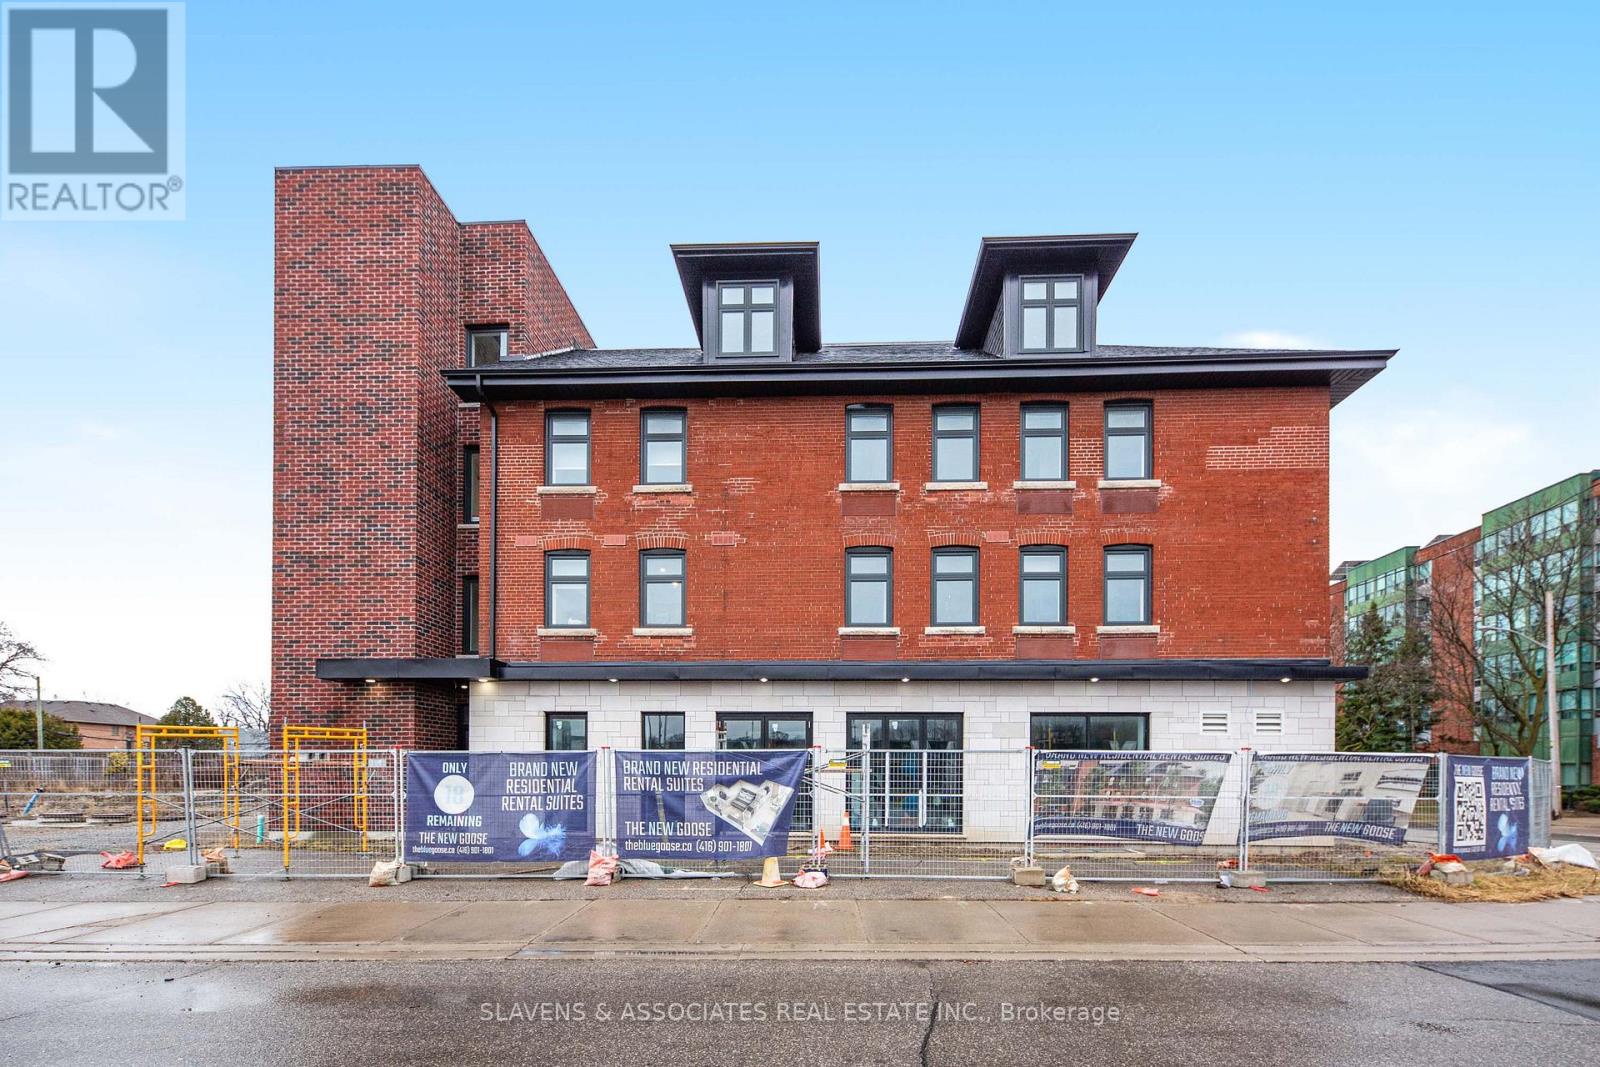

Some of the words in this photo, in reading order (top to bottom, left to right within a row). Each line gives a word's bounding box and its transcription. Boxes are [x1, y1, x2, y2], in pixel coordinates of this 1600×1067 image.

[442, 762, 468, 774] ONLY
[509, 761, 547, 777] BRAND
[551, 761, 579, 776] NEW
[623, 760, 661, 775] BRAND
[664, 761, 691, 775] NEW
[692, 761, 763, 776] RESIDENTIAL
[506, 778, 578, 794] RESIDENTIAL
[623, 777, 664, 792] RENTAL
[666, 777, 704, 792] SUITES
[501, 795, 543, 811] RENTAL
[545, 795, 584, 810] SUITES
[426, 815, 482, 827] REMAINING
[625, 821, 645, 836] THE
[648, 822, 674, 836] NEW
[676, 822, 712, 837] GOOSE
[419, 831, 436, 844] THE
[437, 832, 458, 844] NEW
[459, 832, 488, 845] GOOSE
[1136, 823, 1154, 836] THE
[1156, 826, 1179, 839] NEW
[1180, 828, 1205, 842] GOOS
[1324, 821, 1339, 833] THE
[1340, 822, 1362, 834] NEW
[1362, 825, 1396, 840] GOOSE
[696, 840, 717, 853] (416)
[718, 840, 753, 853] 901-1801
